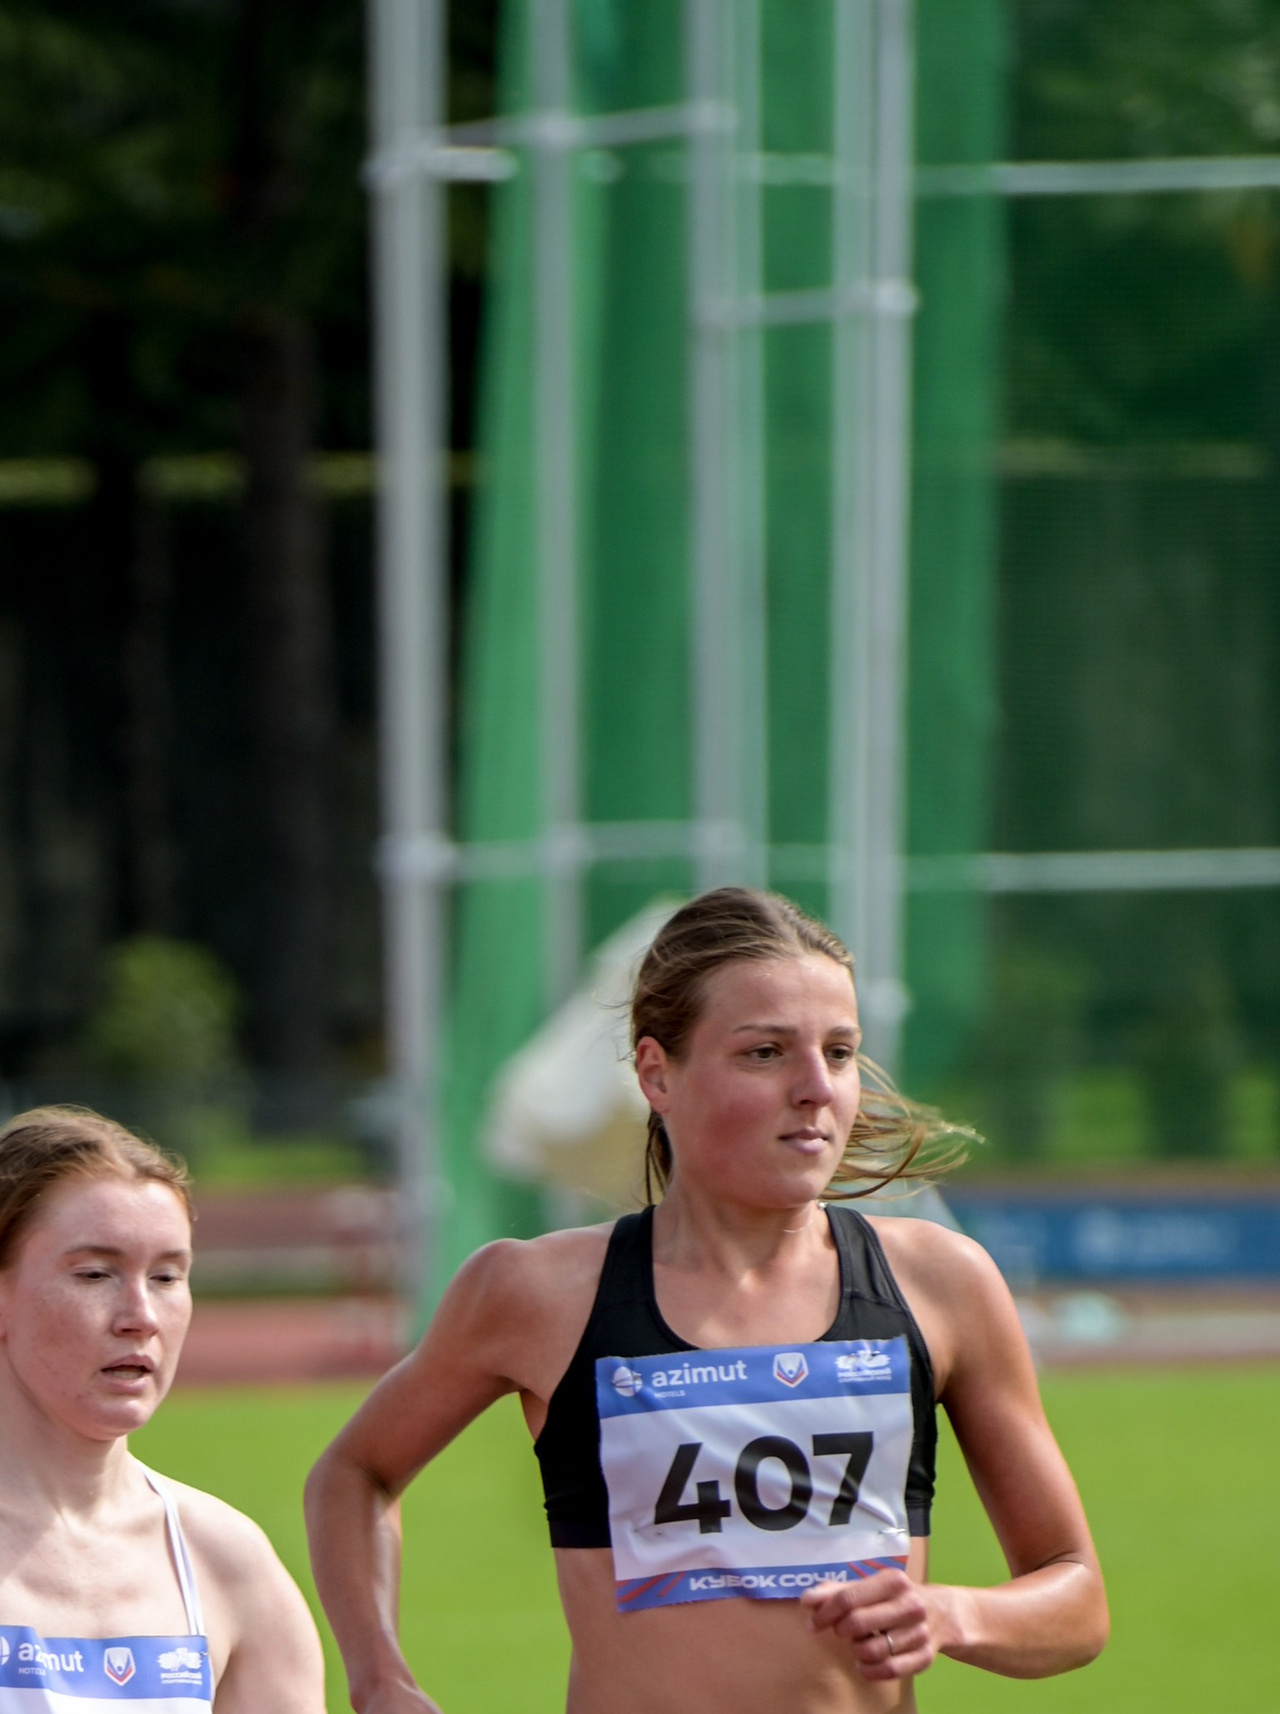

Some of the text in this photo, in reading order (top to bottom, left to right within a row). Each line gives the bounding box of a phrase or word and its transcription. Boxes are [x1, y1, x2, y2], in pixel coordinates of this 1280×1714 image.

[652, 1360, 748, 1388] azimut
[654, 1431, 874, 1534] 407
[690, 1573, 777, 1591] КУБОК
